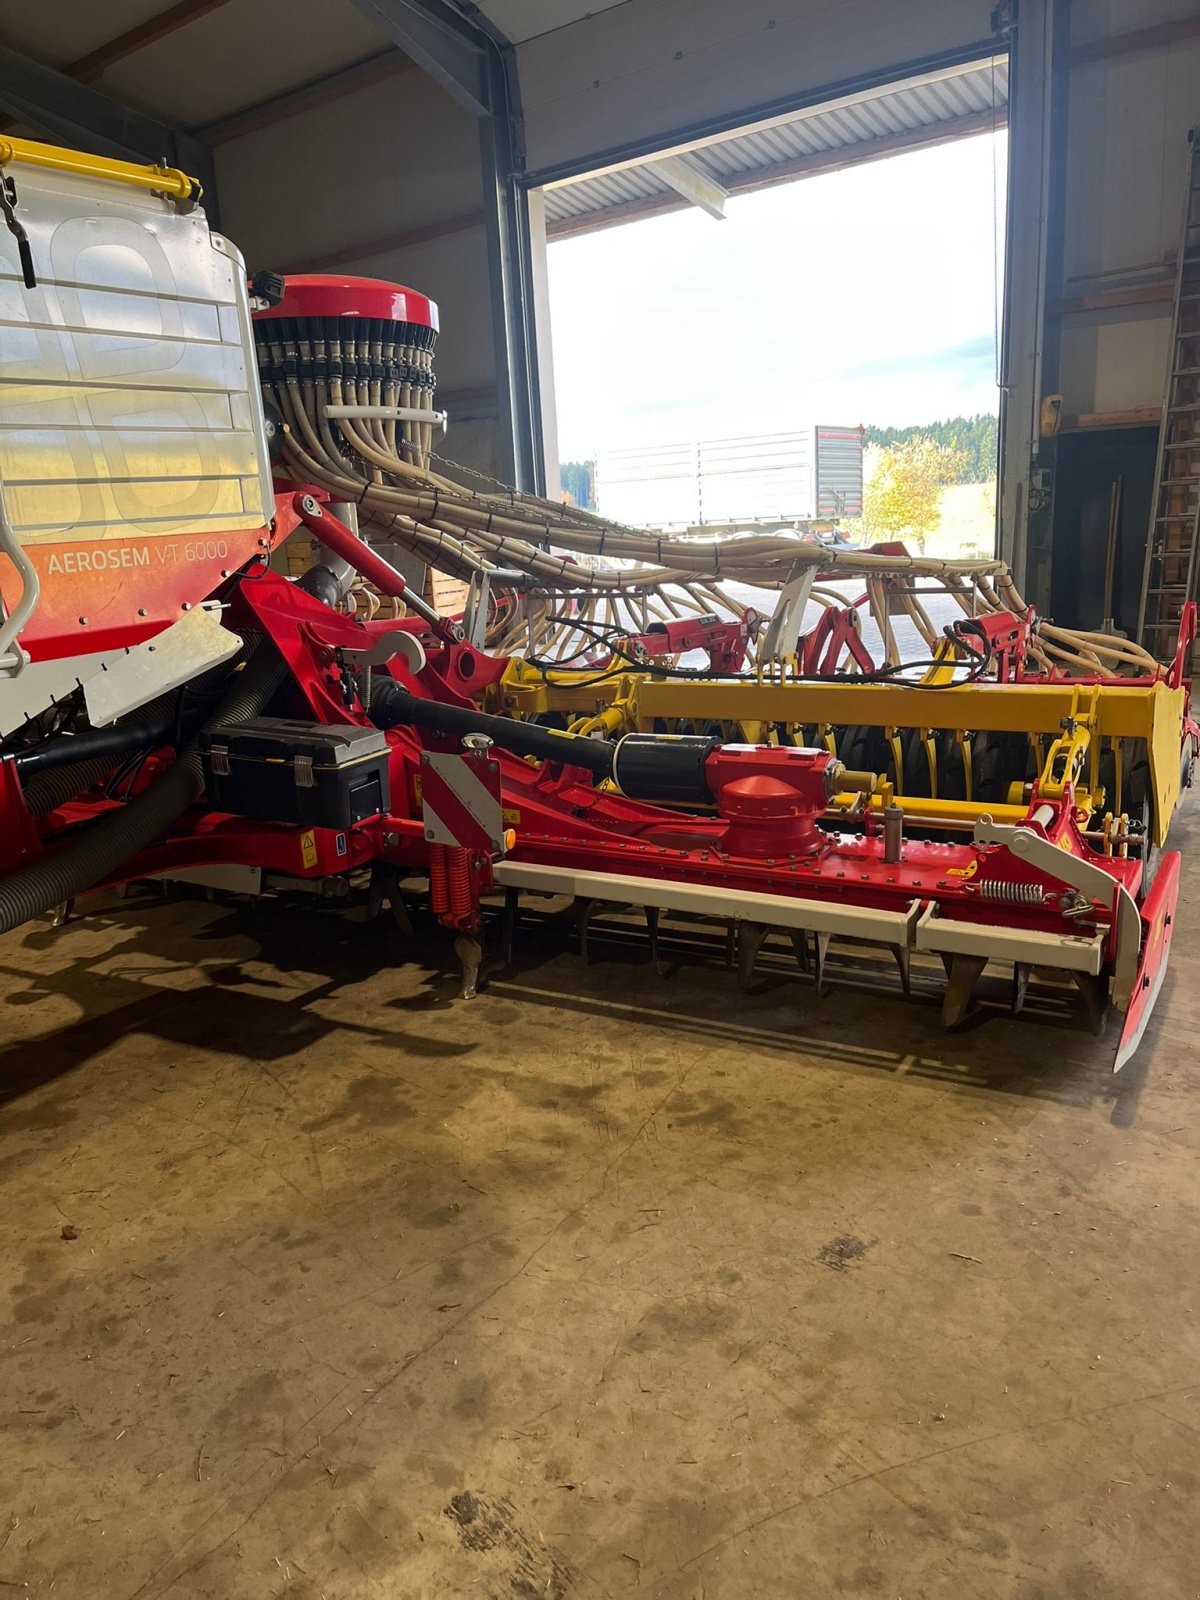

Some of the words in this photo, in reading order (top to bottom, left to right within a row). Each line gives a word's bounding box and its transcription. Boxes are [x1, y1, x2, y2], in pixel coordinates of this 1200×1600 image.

[47, 547, 150, 574] AEROSEM
[154, 544, 179, 563] VT
[184, 540, 228, 561] 6000
